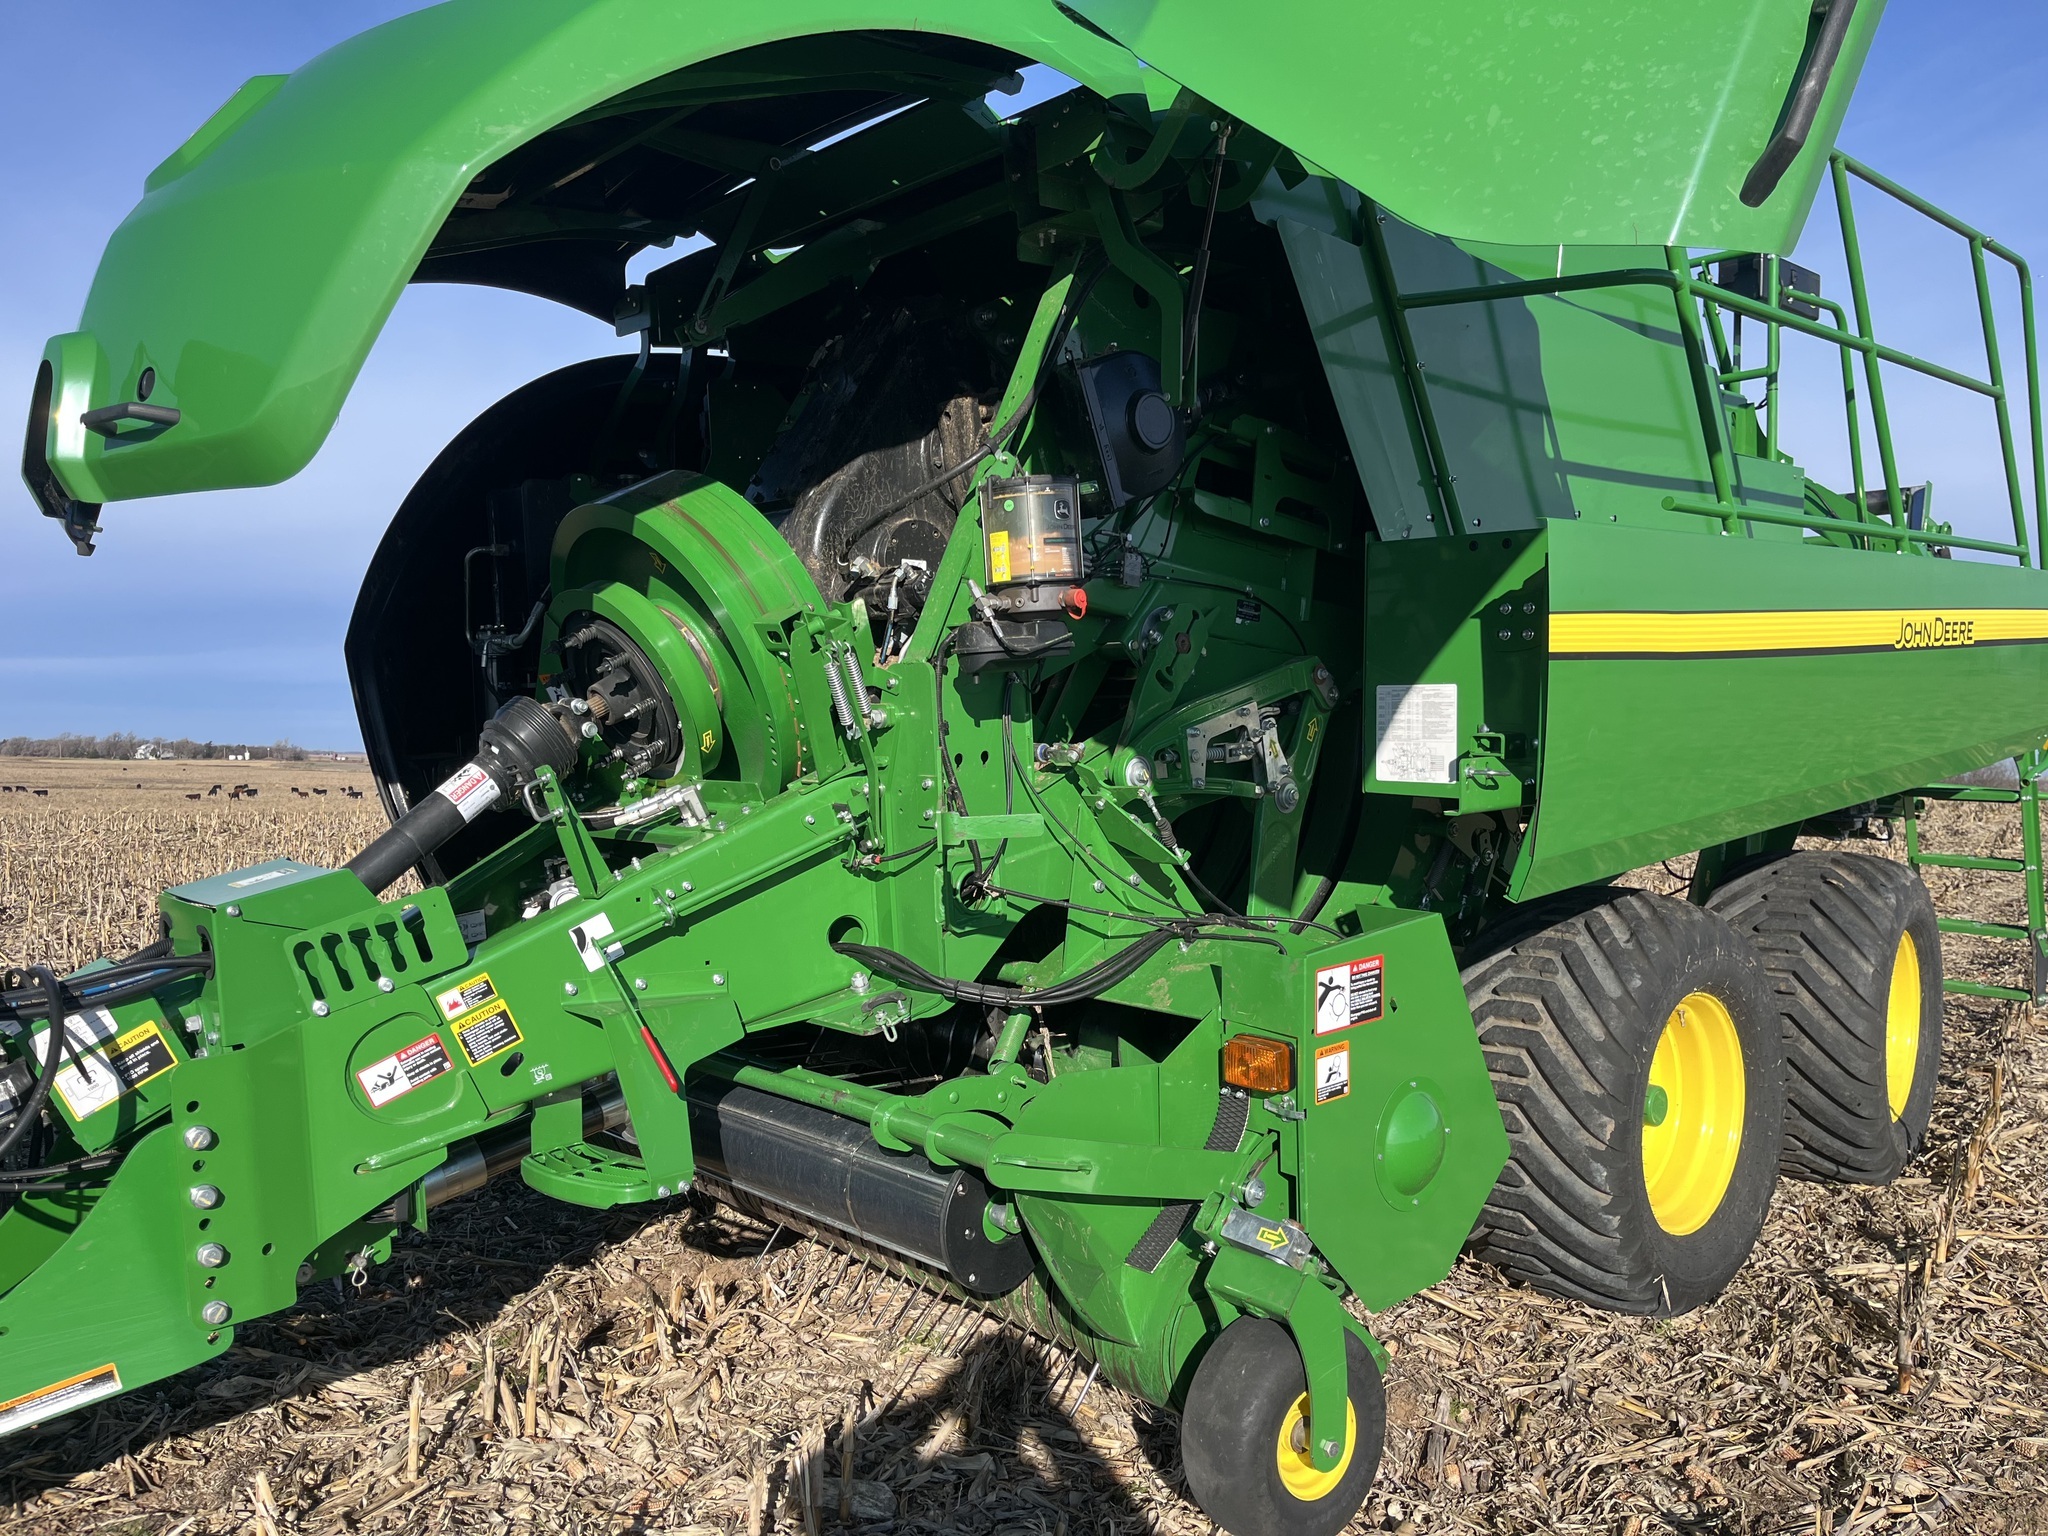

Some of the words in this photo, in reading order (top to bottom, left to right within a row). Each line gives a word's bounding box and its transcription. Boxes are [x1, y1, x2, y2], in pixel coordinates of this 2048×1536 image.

[1896, 618, 1932, 644] JOHN
[1934, 617, 1974, 642] DEERE
[450, 778, 477, 800] DANGER
[1358, 960, 1380, 971] DANGER
[464, 974, 486, 988] CAUTION
[464, 1003, 501, 1026] CAUTION
[117, 1027, 150, 1049] CAUTION
[406, 1038, 434, 1055] DANGER
[1324, 1044, 1344, 1054] WARNING
